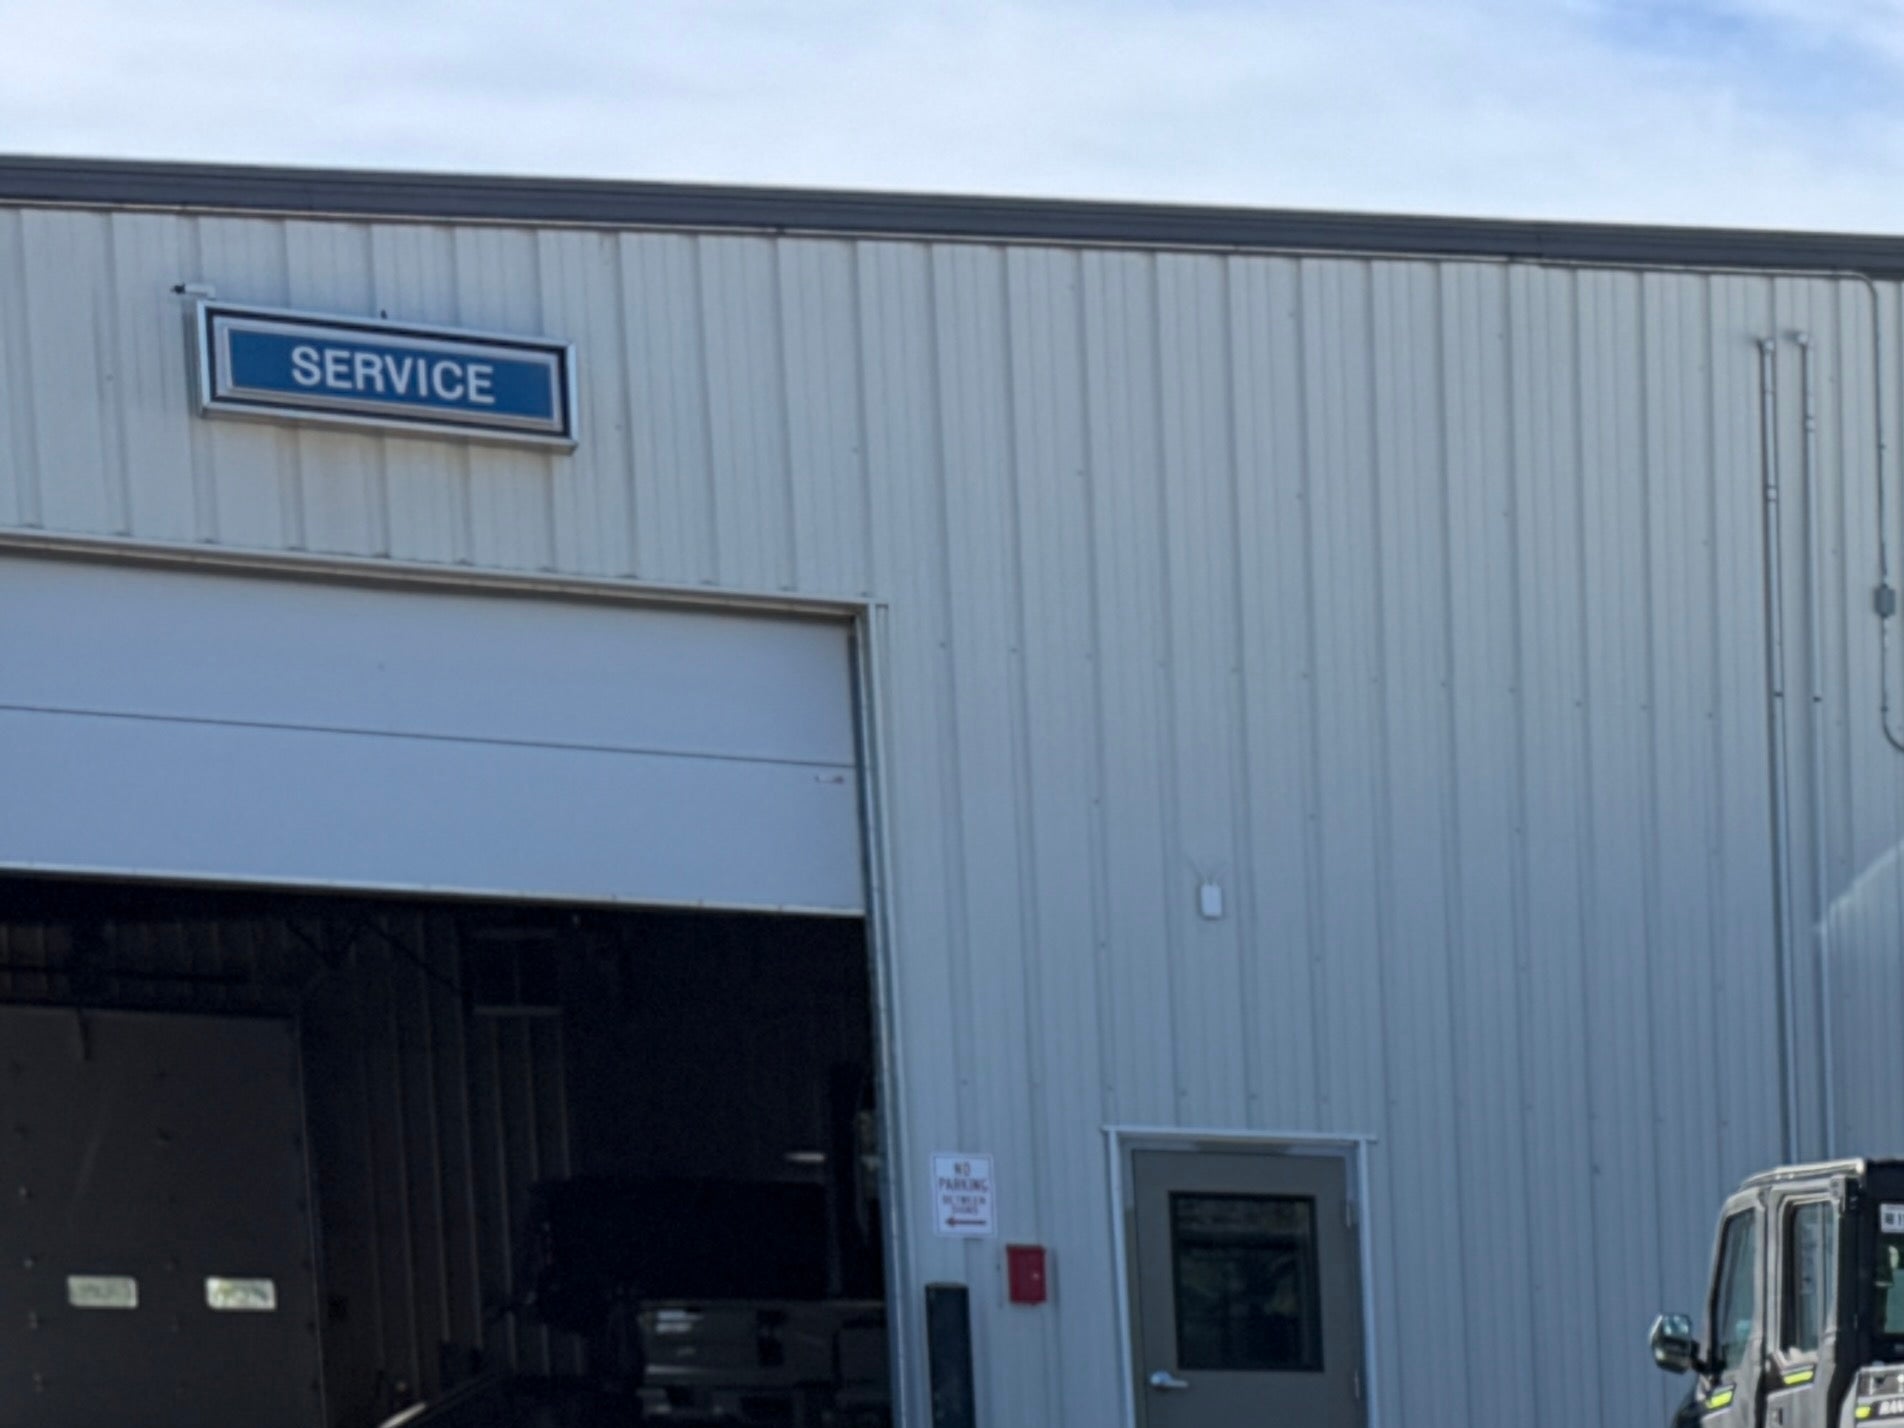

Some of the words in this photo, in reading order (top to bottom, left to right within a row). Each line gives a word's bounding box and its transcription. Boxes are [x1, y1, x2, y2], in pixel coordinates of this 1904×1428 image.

[291, 346, 495, 404] SERVICE
[954, 1162, 971, 1177] NO
[938, 1177, 989, 1193] PARKING
